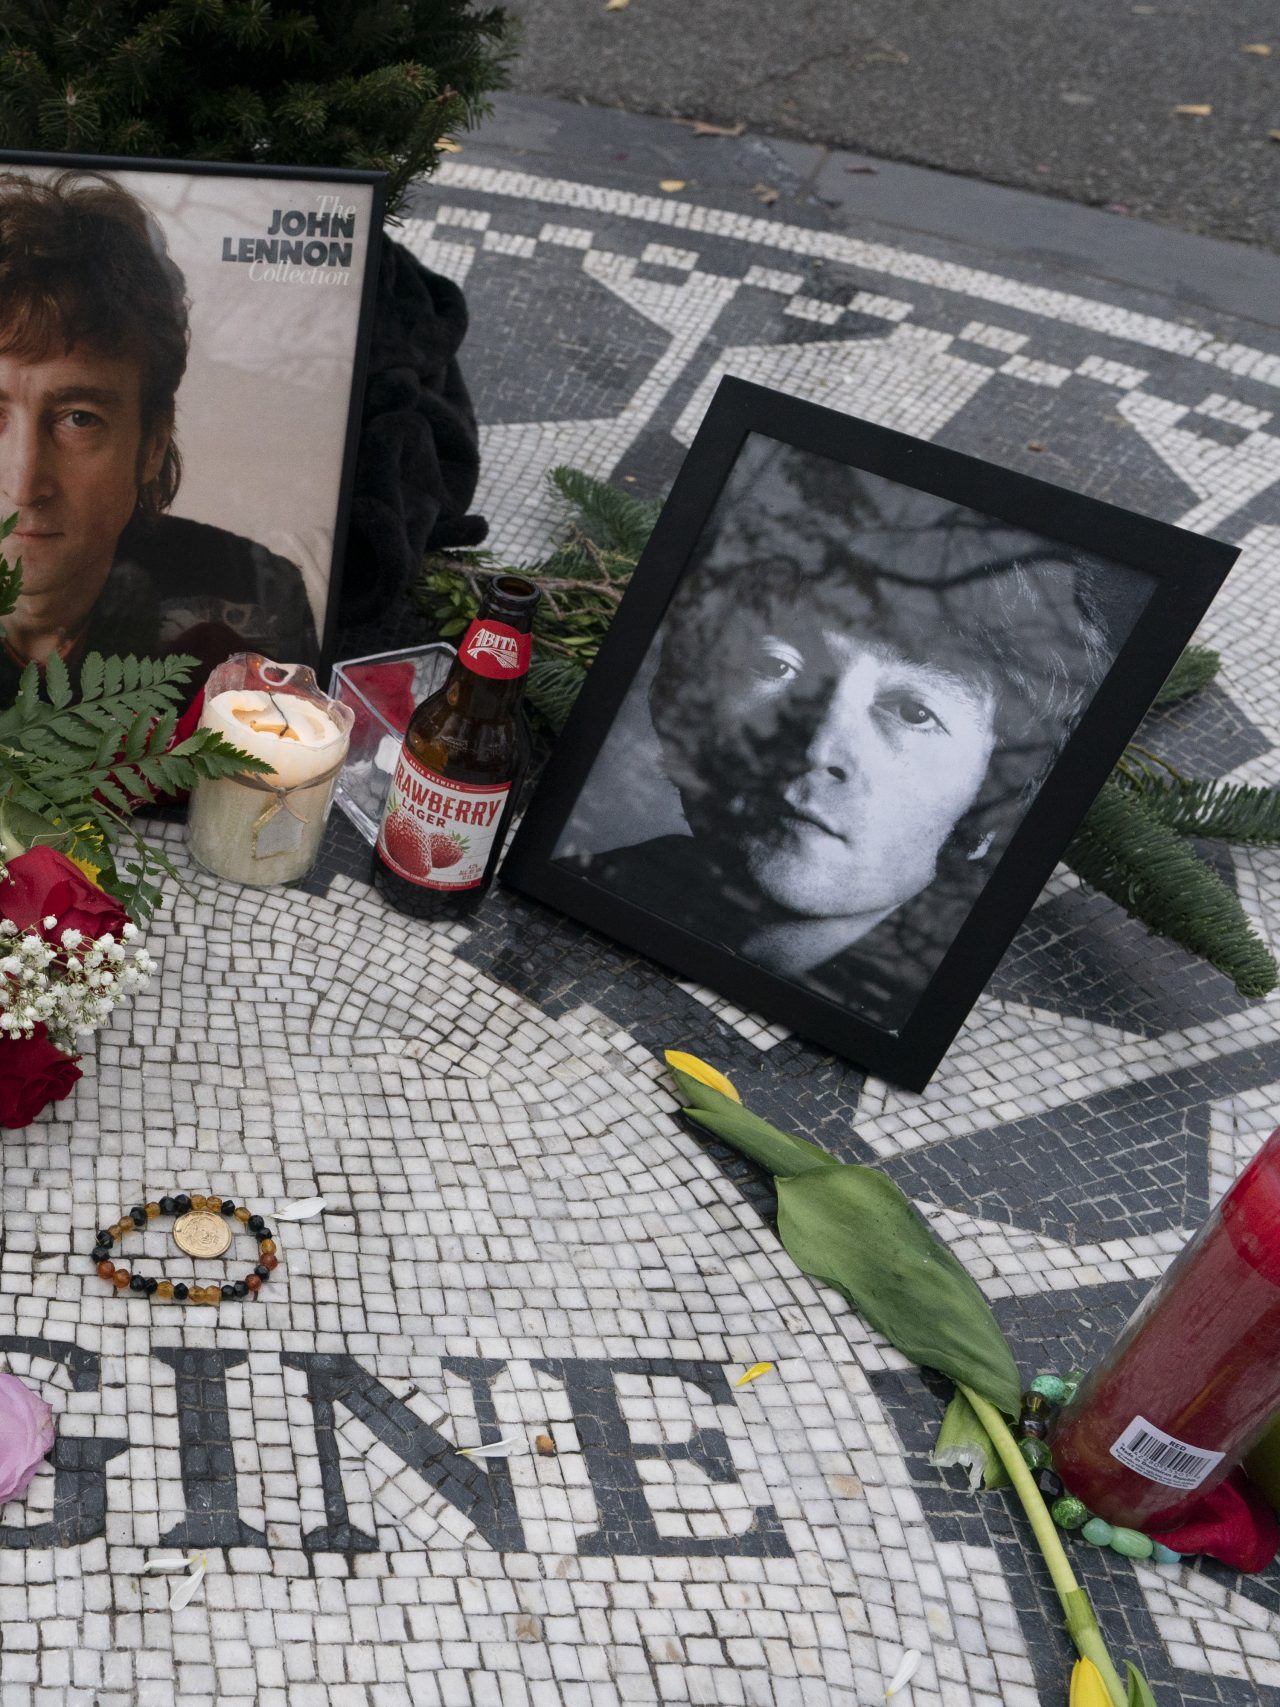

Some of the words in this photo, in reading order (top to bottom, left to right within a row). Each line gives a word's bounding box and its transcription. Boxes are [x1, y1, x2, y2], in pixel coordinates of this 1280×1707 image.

[315, 195, 357, 220] The
[267, 209, 356, 239] JOHN
[222, 237, 353, 267] LENNON
[248, 259, 350, 286] Collection
[468, 628, 518, 652] ABITA
[395, 762, 502, 827] RAWBERRY
[402, 797, 446, 828] LAGER
[1169, 1441, 1187, 1451] RED
